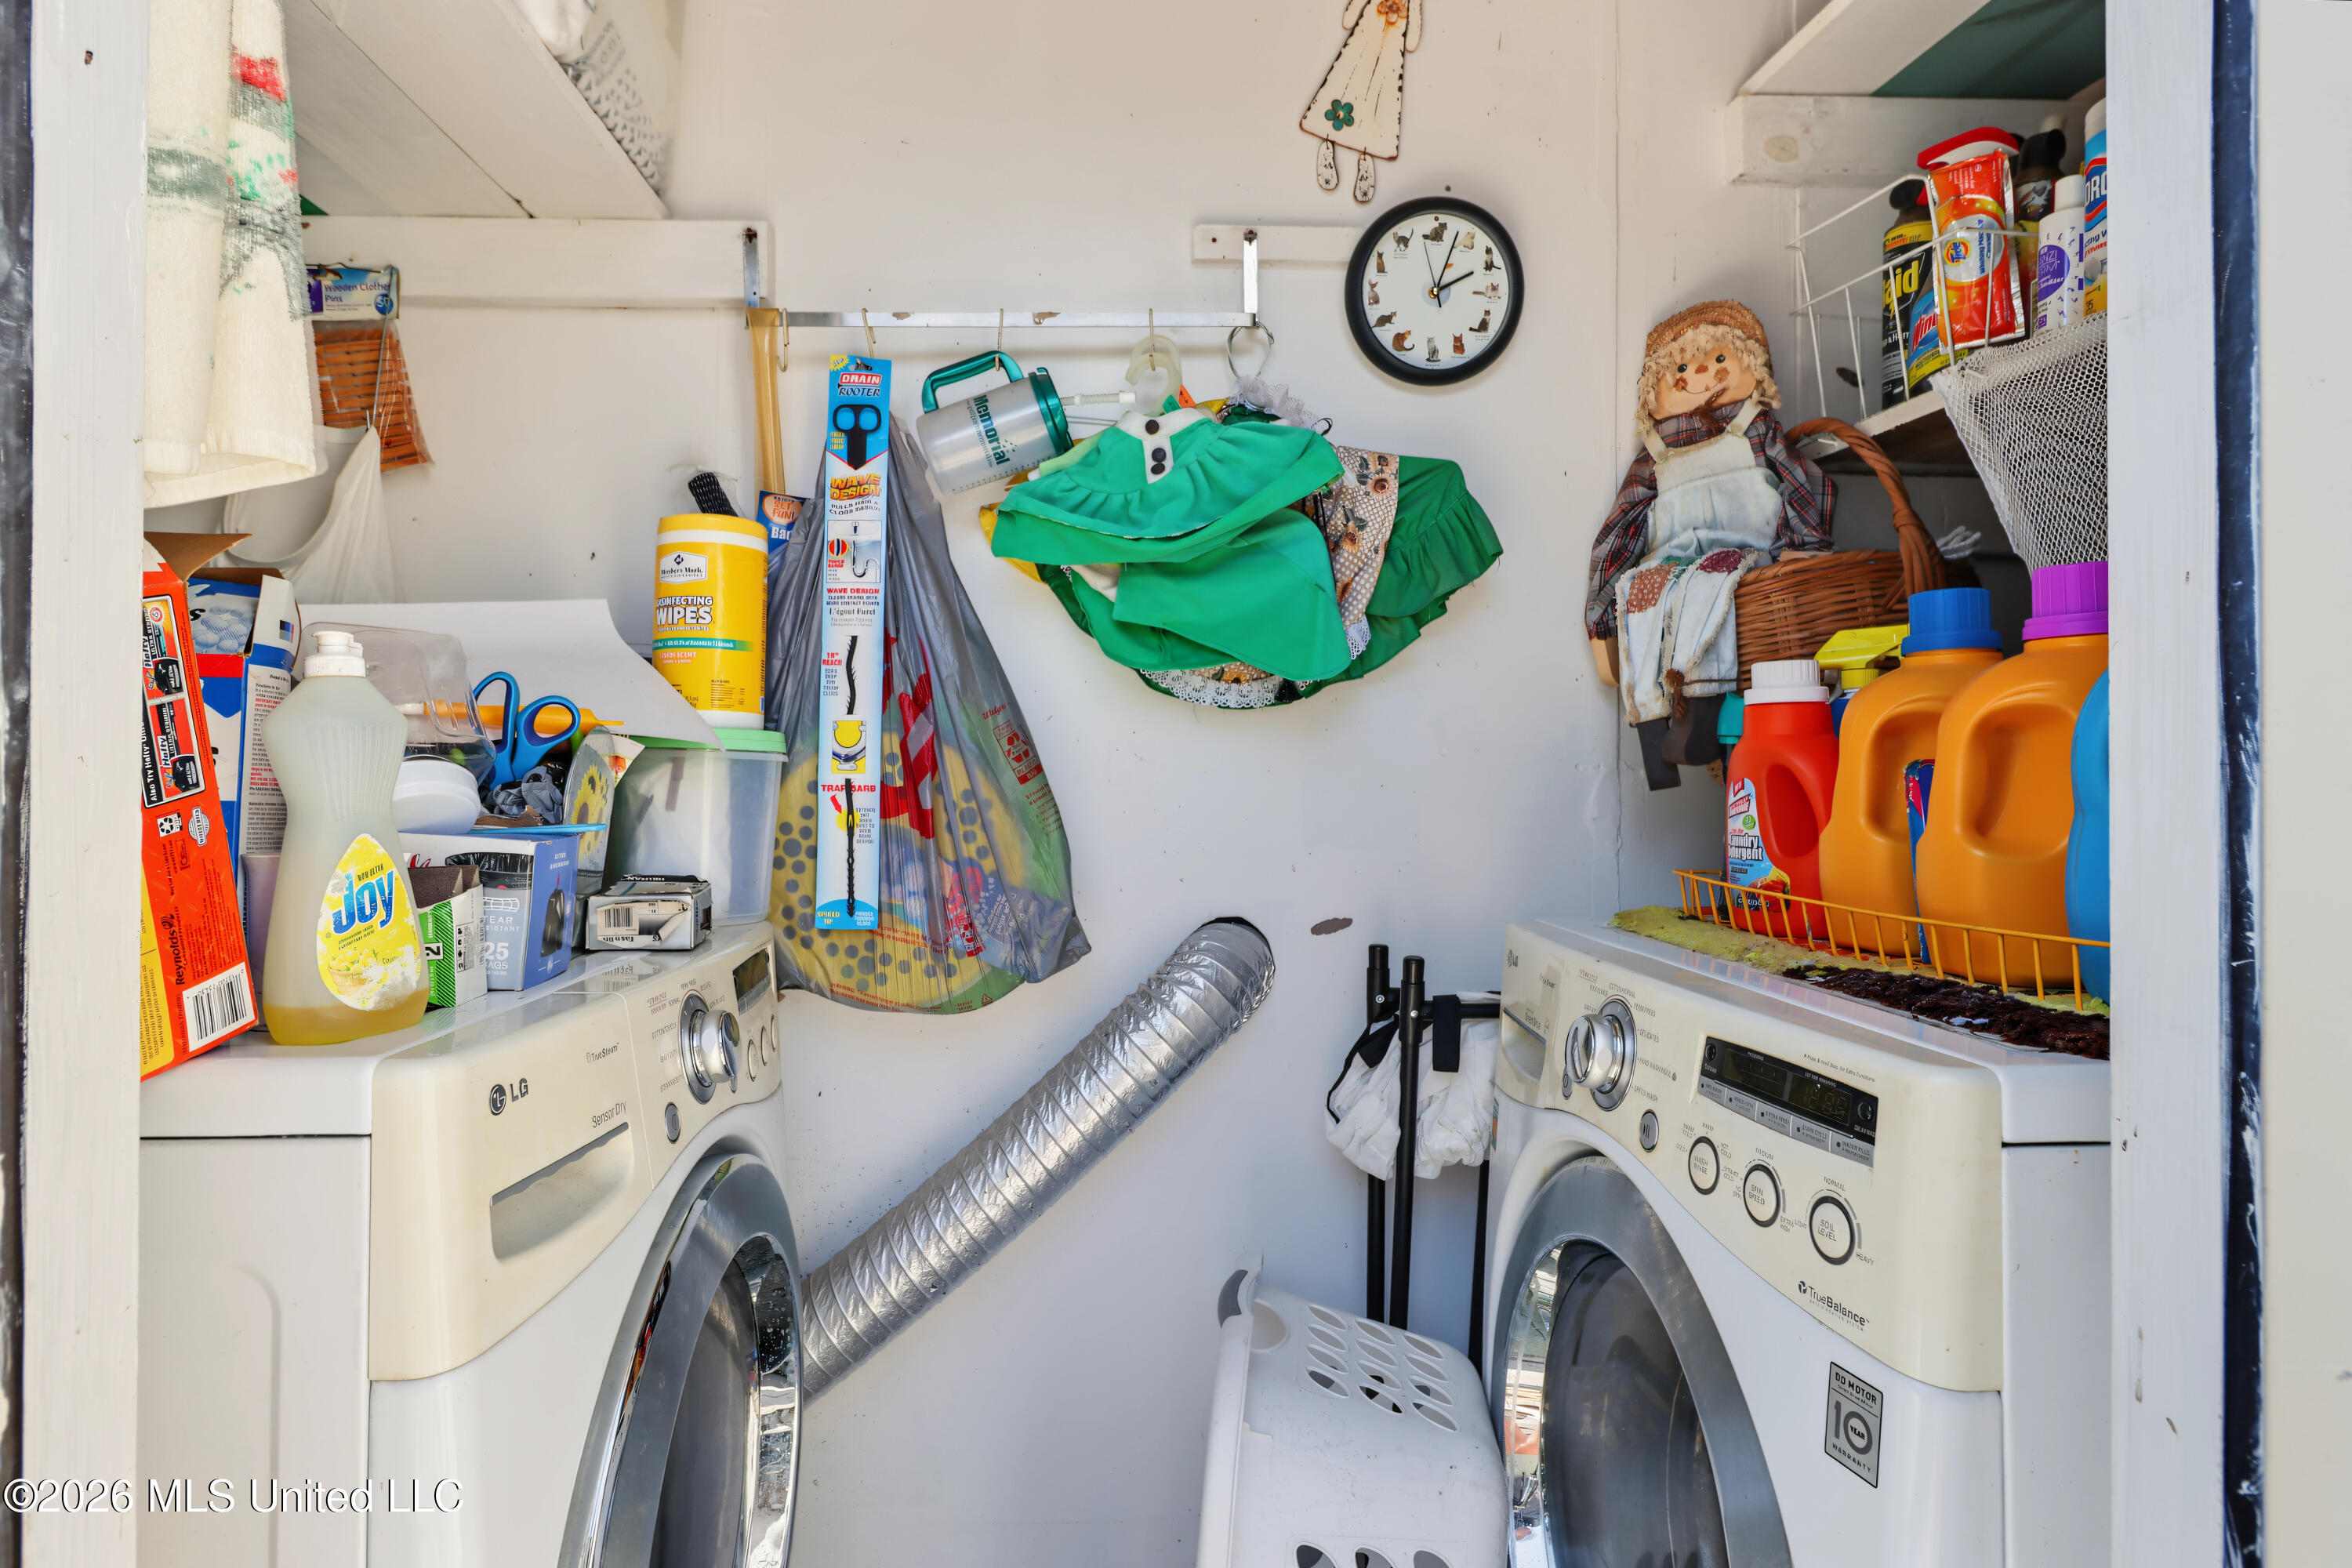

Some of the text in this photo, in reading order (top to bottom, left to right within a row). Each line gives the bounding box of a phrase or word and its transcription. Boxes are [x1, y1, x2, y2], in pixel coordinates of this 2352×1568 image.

[1950, 242, 1966, 263] Tide
[1882, 260, 1919, 309] aid
[841, 374, 881, 385] DRAIN
[838, 387, 880, 397] ROOTER
[973, 394, 1011, 466] Memorial
[830, 473, 881, 490] WAVE
[829, 484, 881, 501] DESIGN
[656, 606, 713, 626] WIPES
[332, 869, 395, 935] Joy
[484, 916, 514, 925] TEAR
[169, 931, 187, 986] Reynolds
[485, 942, 510, 961] 25
[510, 1078, 529, 1103] LG
[591, 1100, 628, 1129] Sensor Dry
[1817, 1227, 1838, 1242] LEVEL
[1820, 1218, 1835, 1233] SOIL
[1808, 1285, 1866, 1327] TrueBalance
[1835, 1371, 1878, 1406] DD MOTOR
[1834, 1399, 1873, 1456] 10
[1849, 1425, 1866, 1441] YEAR
[1831, 1442, 1872, 1474] WARRANTY
